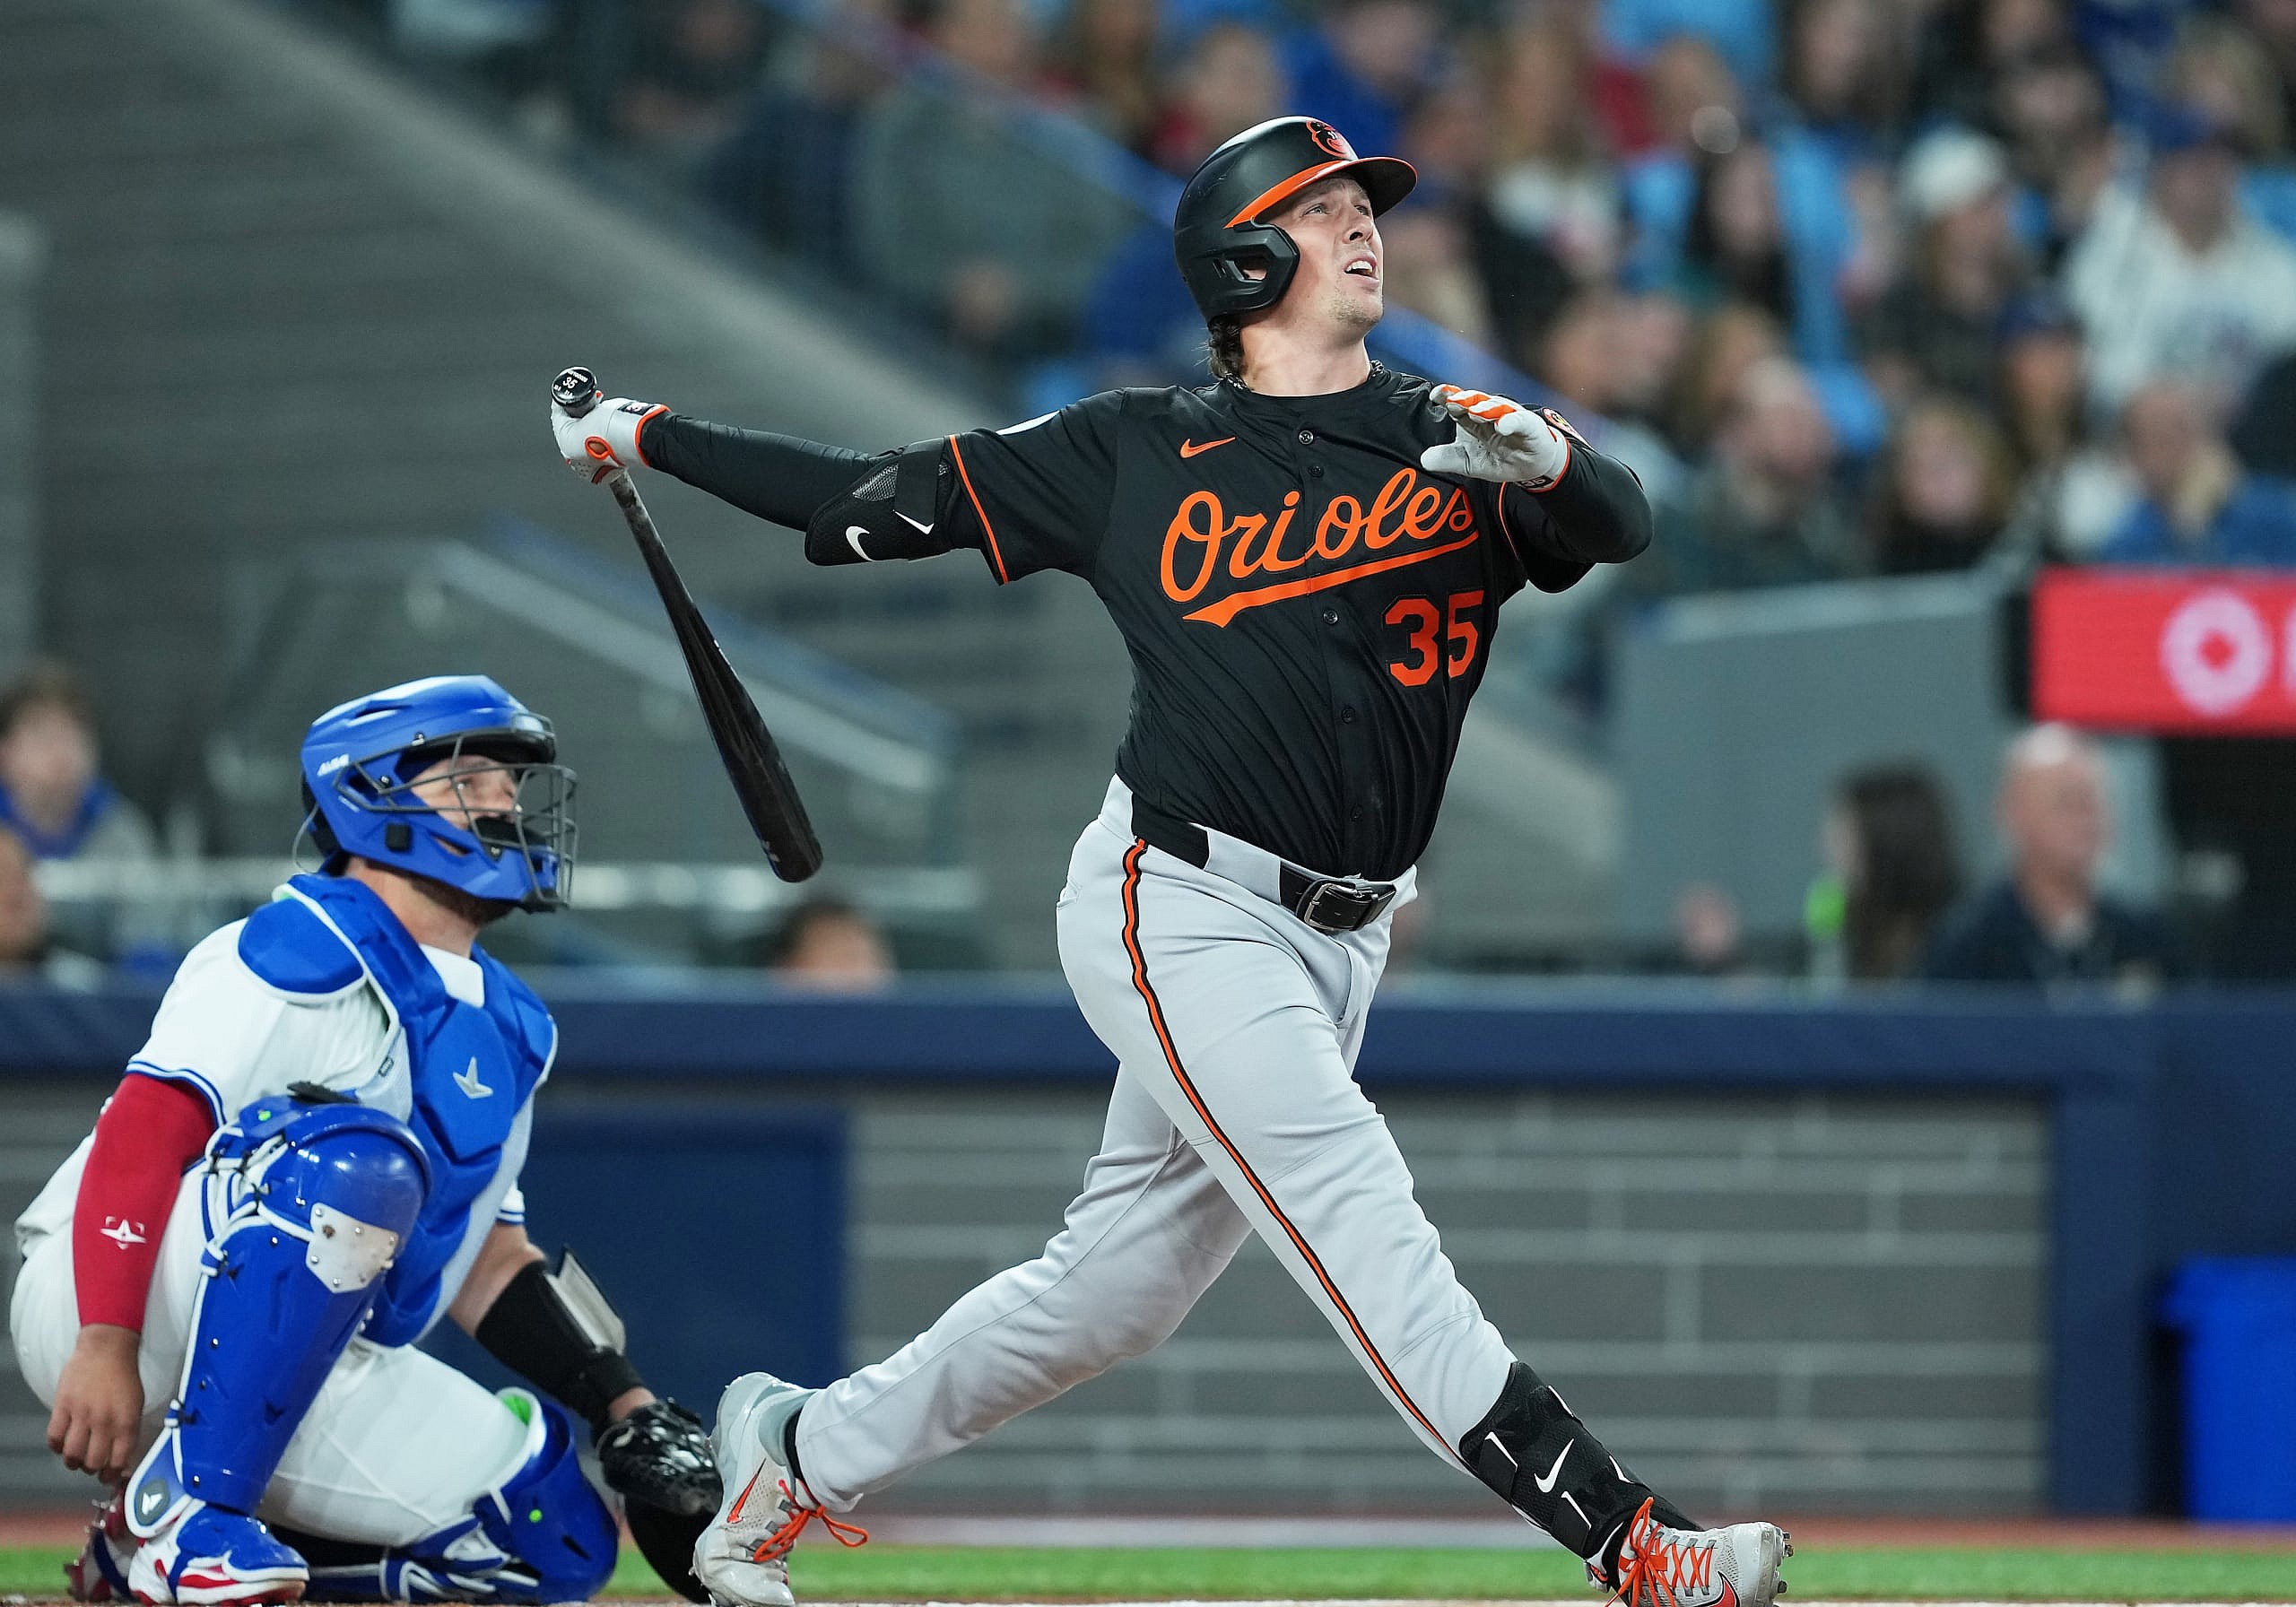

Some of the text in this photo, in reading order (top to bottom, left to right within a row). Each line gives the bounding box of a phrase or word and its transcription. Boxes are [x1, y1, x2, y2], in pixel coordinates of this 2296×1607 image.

[562, 377, 578, 389] 35
[1160, 467, 1474, 602] Orioles
[1385, 589, 1484, 687] 35
